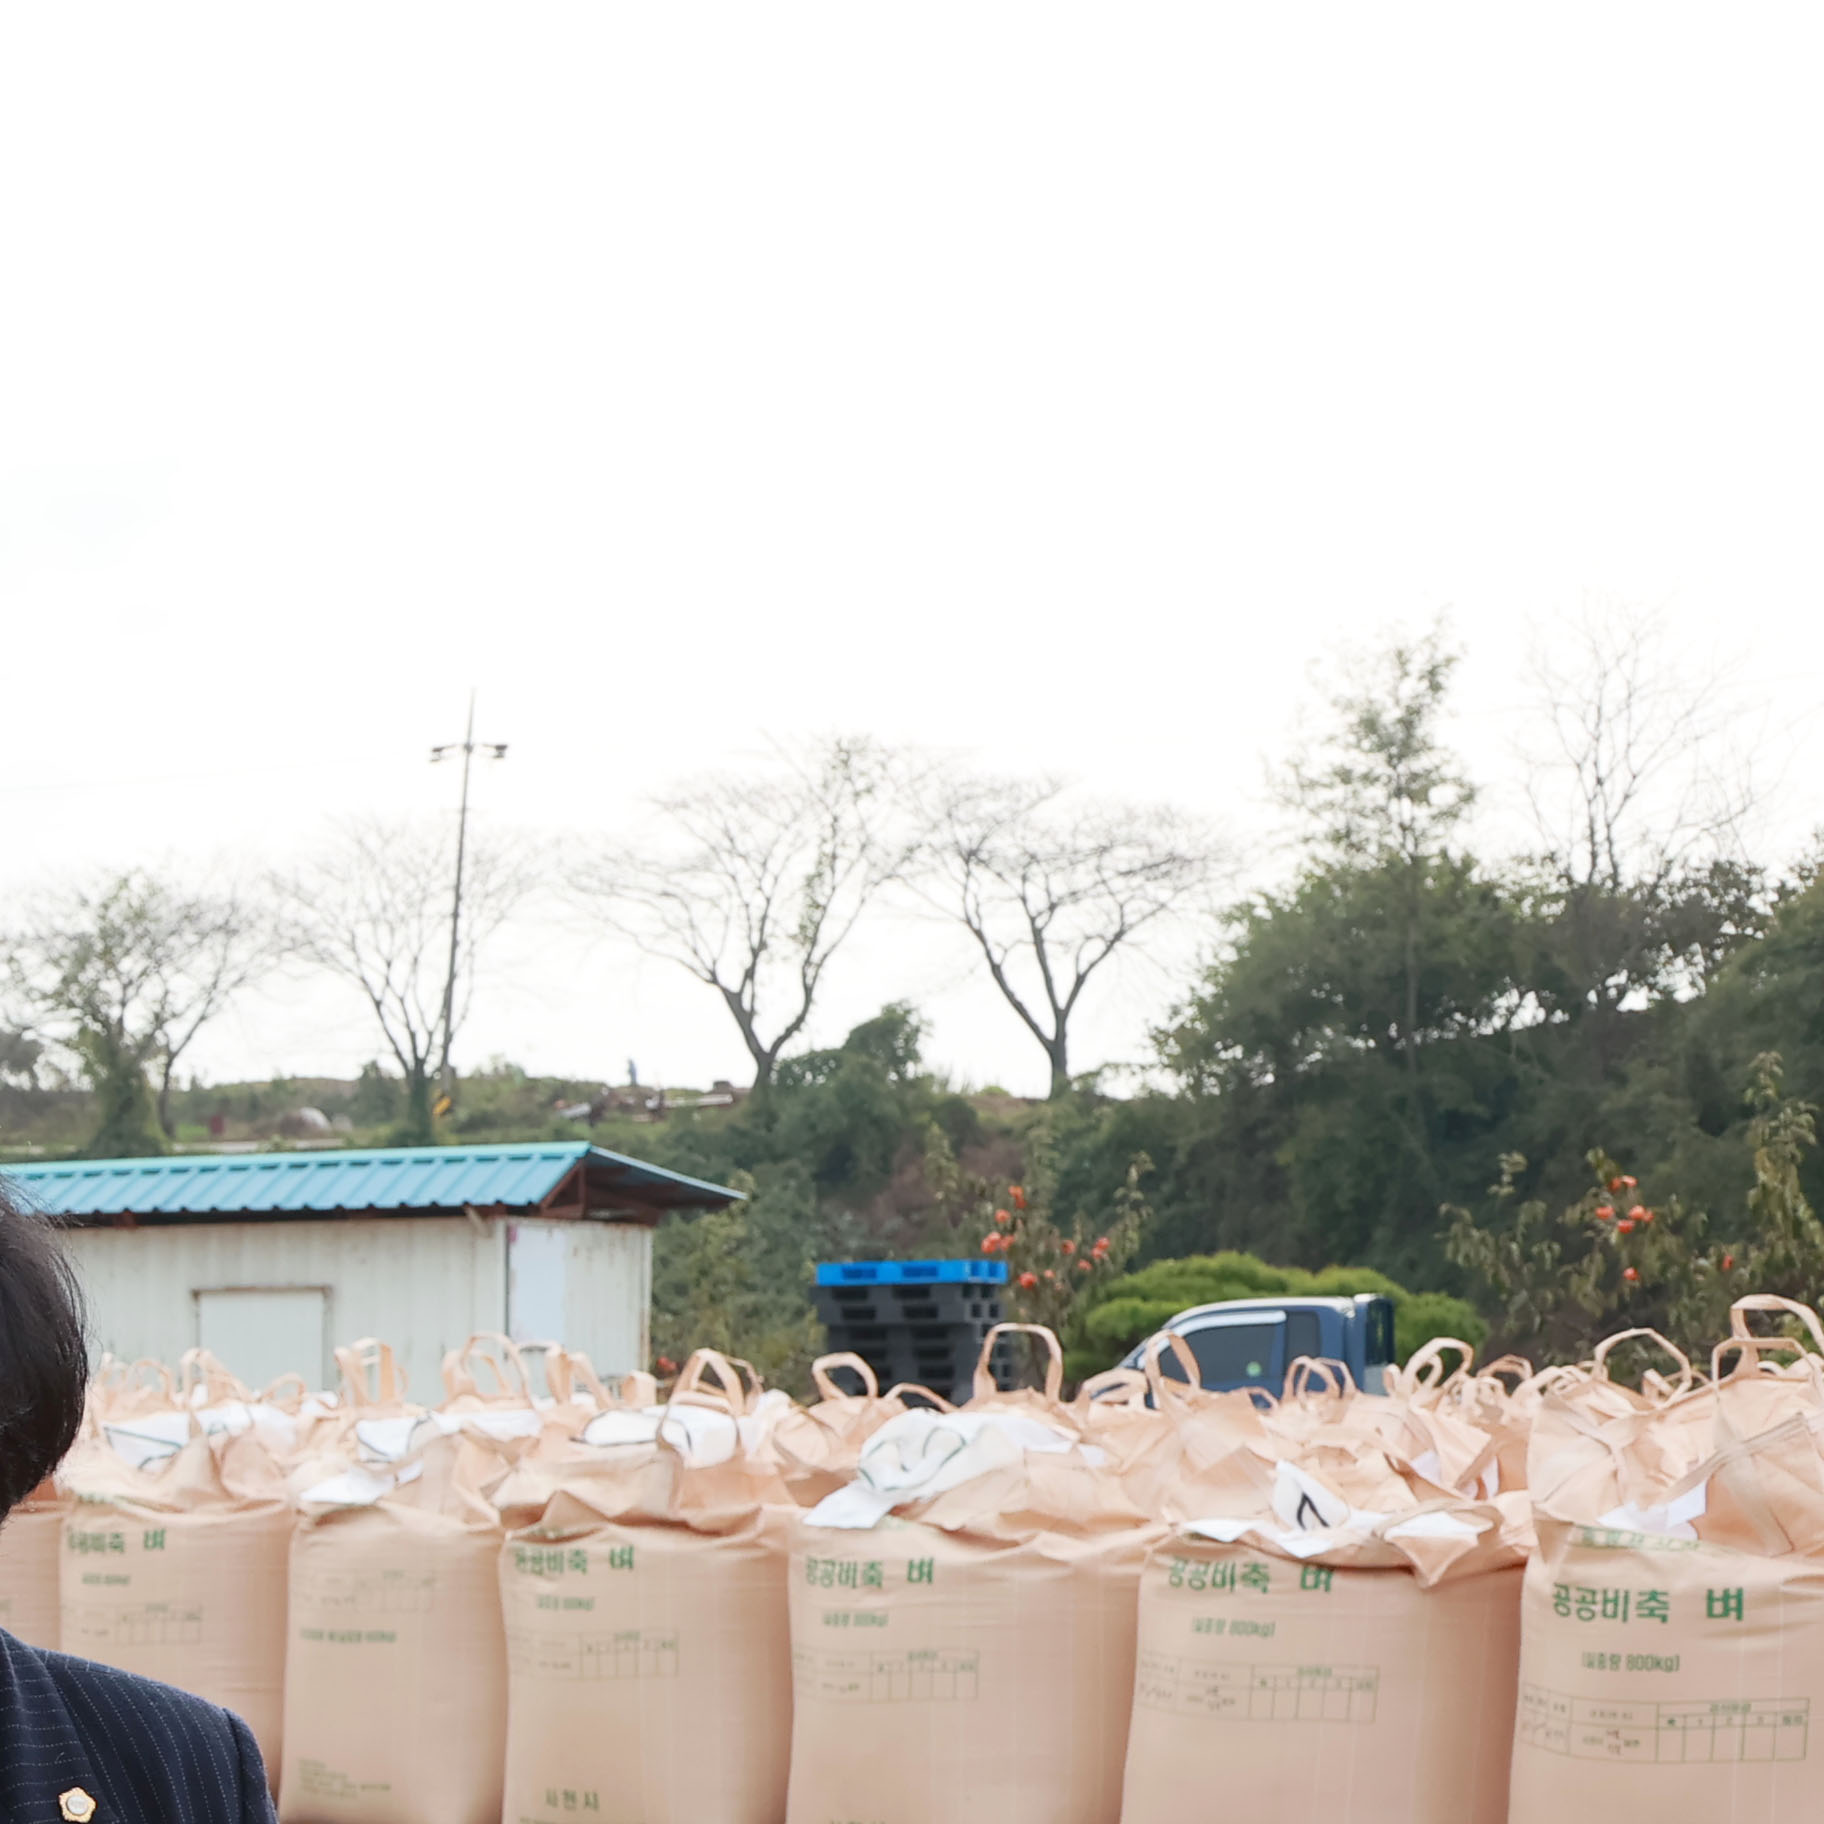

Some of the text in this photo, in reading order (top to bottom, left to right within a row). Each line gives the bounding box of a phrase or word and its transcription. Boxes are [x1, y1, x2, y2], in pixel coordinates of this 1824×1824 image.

[1169, 1556, 1270, 1594] 공공비축
[1552, 1582, 1745, 1623] 공공비축 벼
